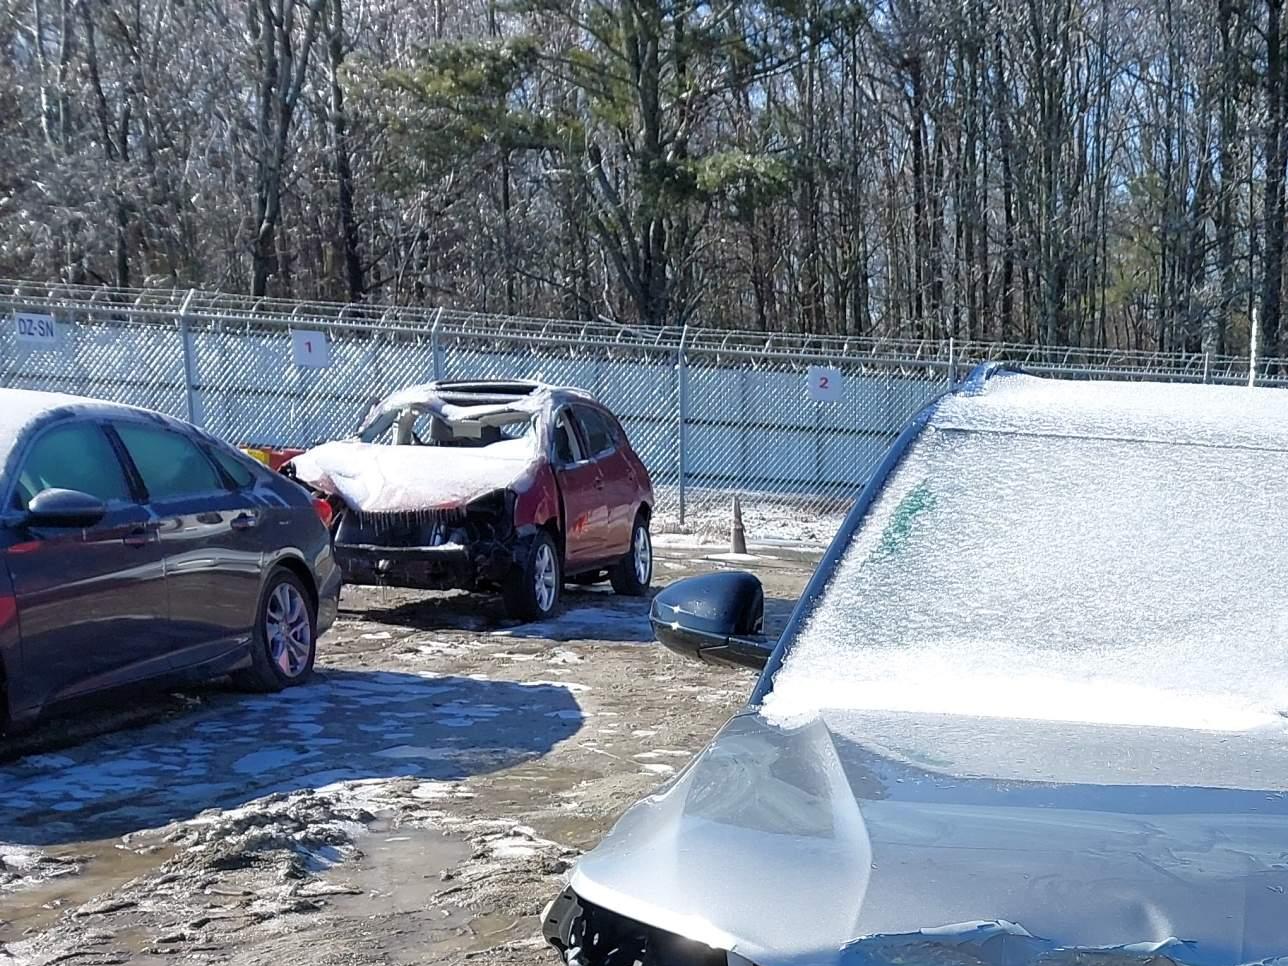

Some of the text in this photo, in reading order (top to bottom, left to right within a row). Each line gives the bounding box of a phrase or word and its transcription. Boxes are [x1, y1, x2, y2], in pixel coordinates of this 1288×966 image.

[18, 318, 54, 337] DZ-SN
[304, 341, 312, 353] 1
[819, 376, 829, 389] 2
